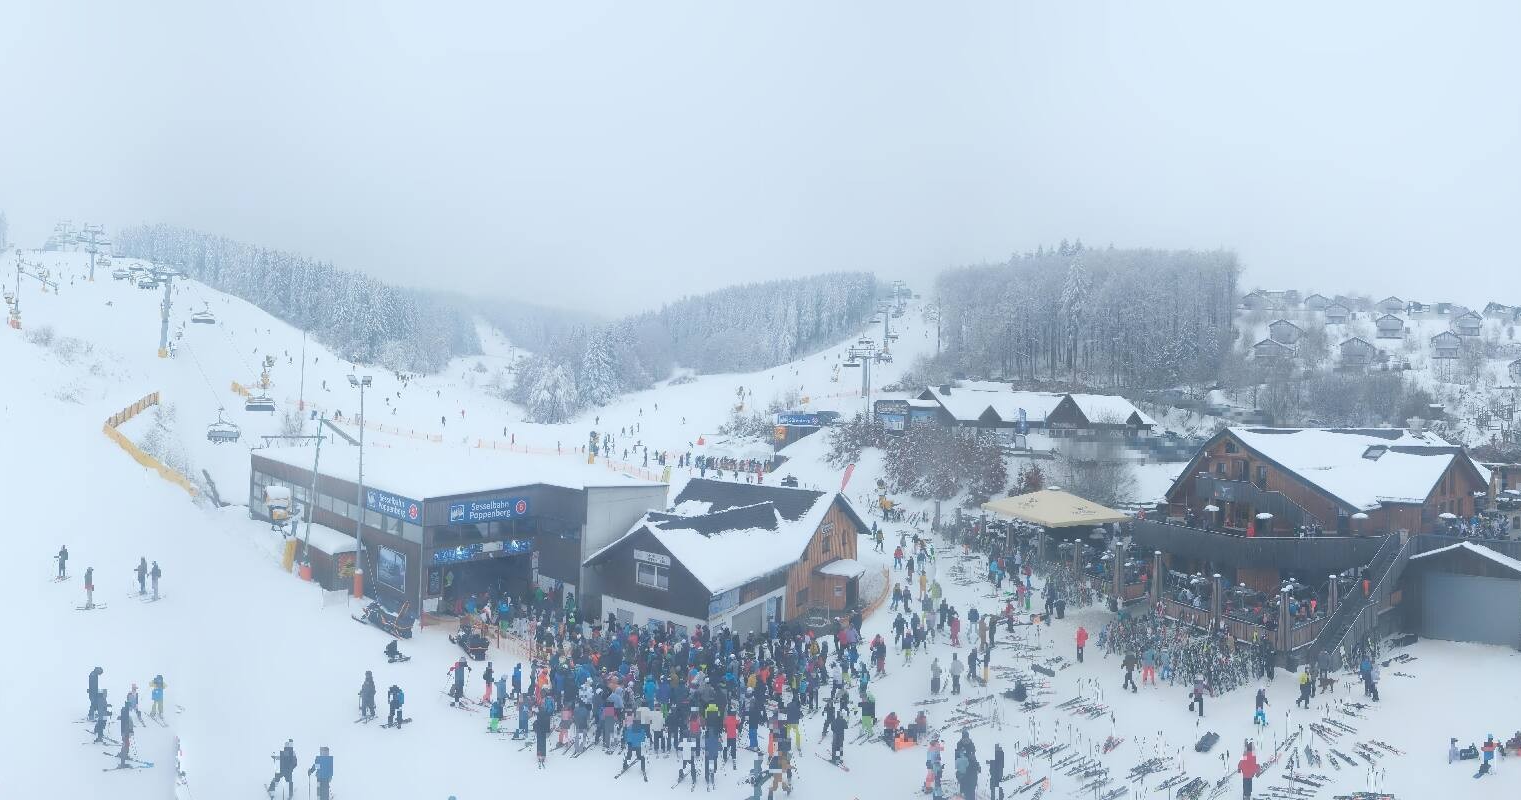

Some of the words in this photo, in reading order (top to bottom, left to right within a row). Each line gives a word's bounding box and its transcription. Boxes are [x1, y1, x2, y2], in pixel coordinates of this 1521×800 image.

[379, 493, 405, 508] Sesselbahn
[471, 500, 510, 511] Sesselbahn
[469, 508, 511, 521] Poppenberg
